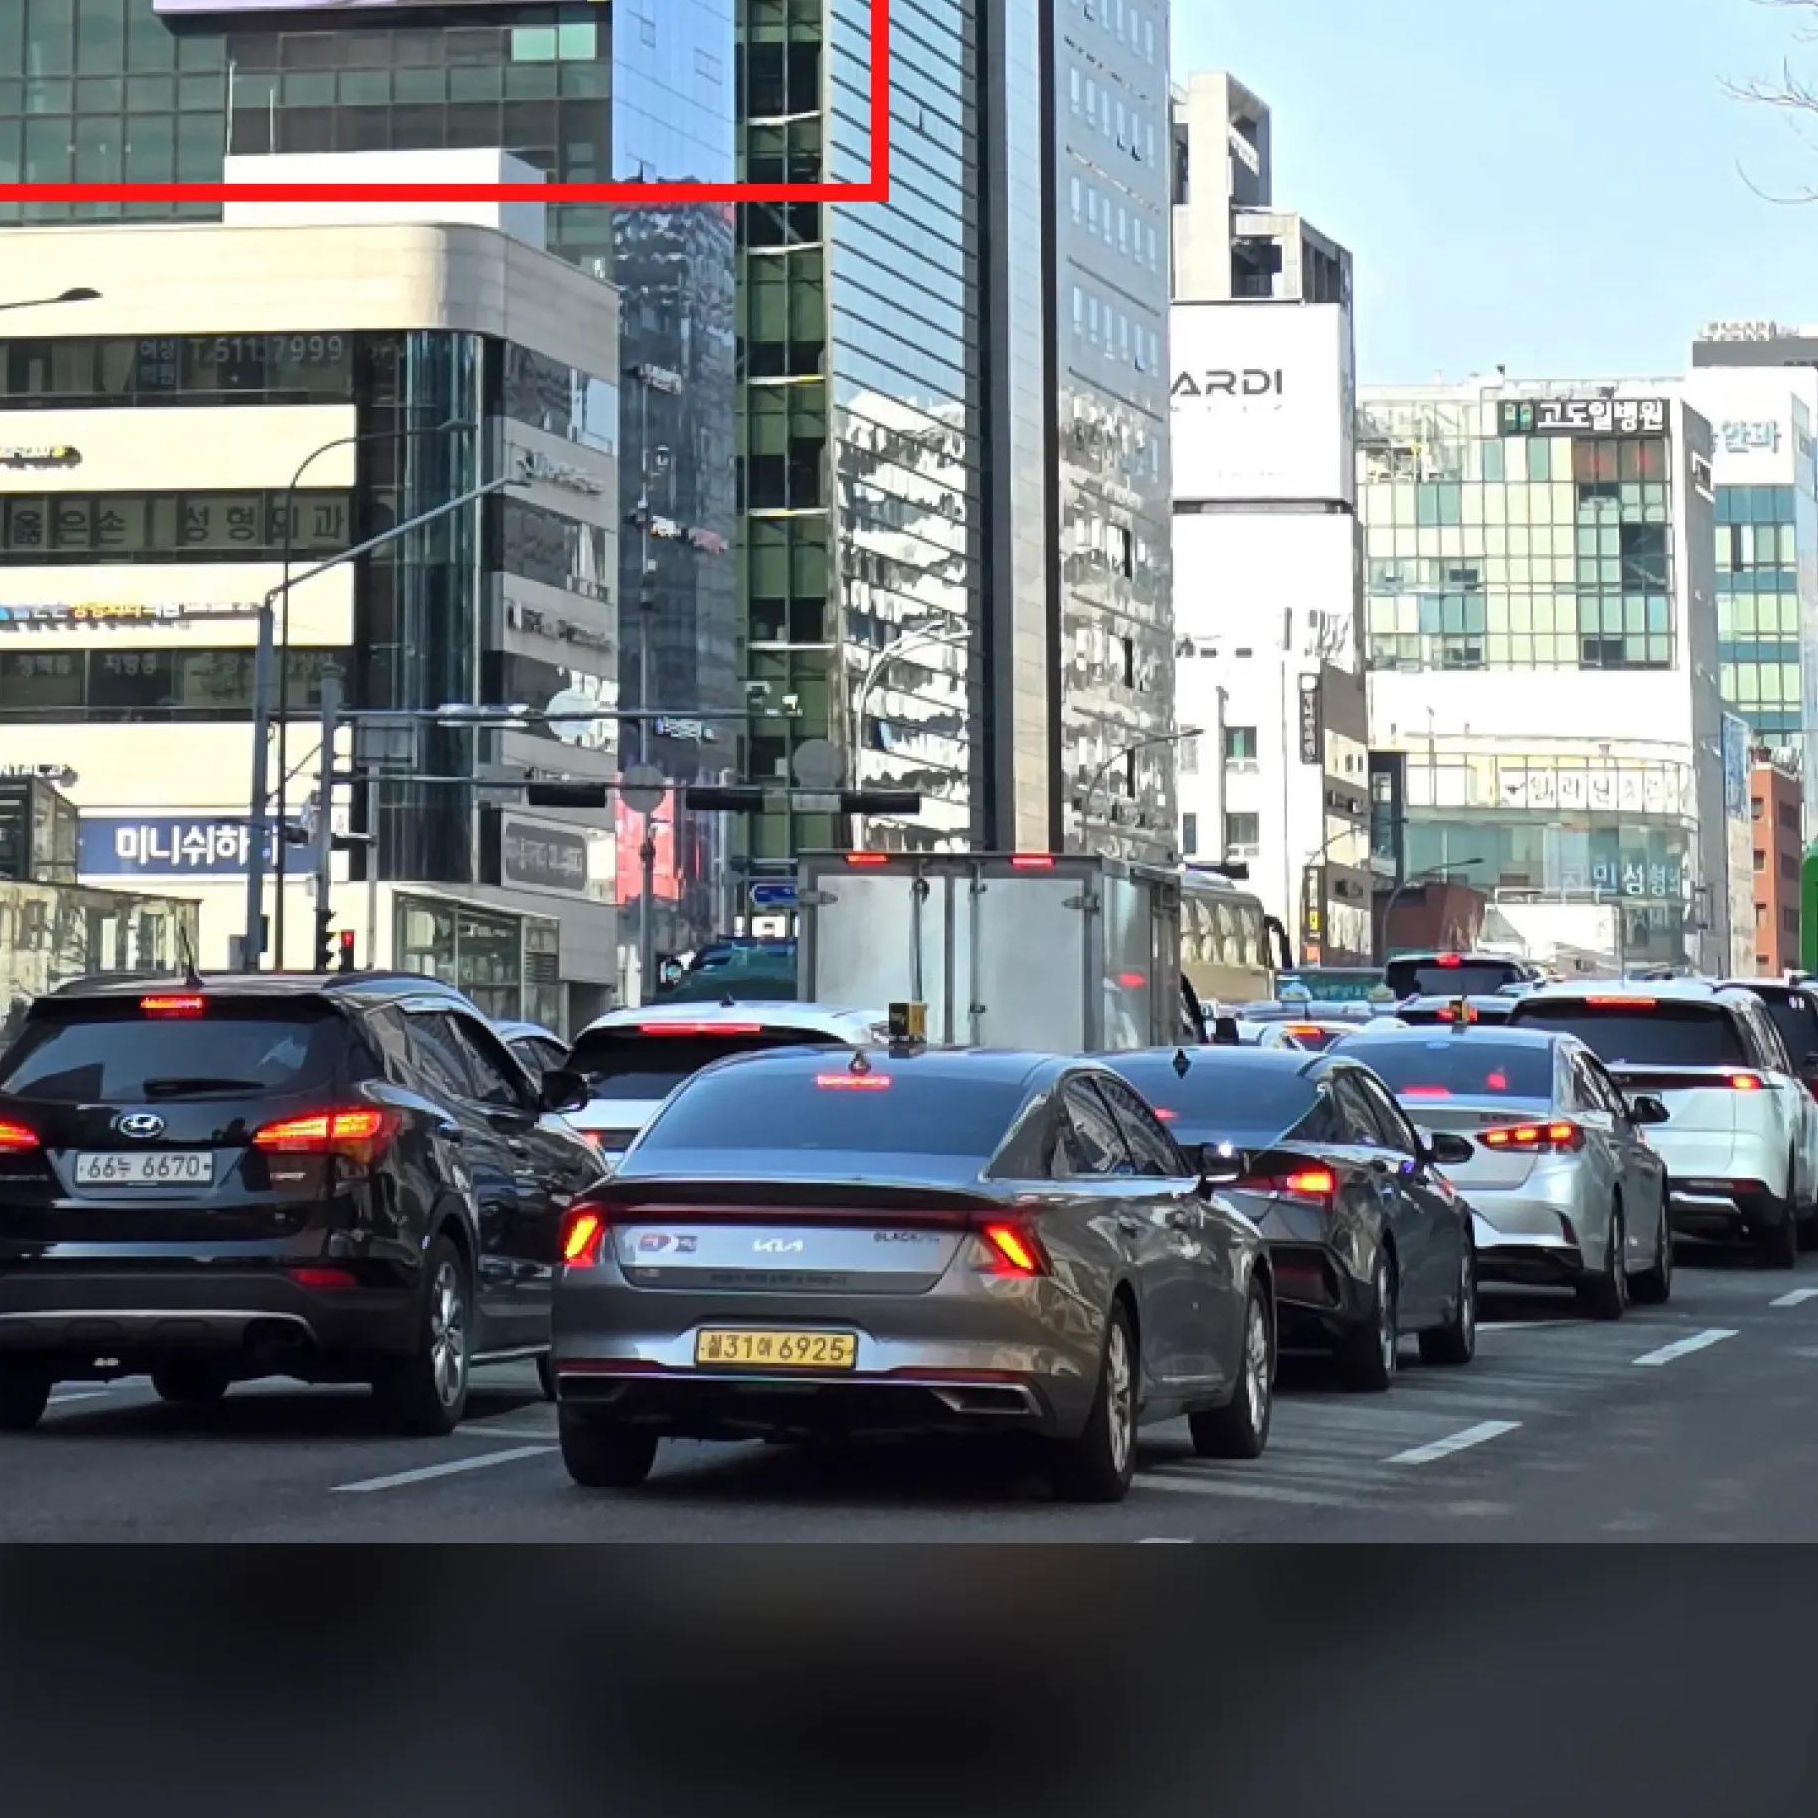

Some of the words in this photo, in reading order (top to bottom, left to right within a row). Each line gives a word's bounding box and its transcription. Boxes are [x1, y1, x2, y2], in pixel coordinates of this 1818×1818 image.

[1169, 368, 1284, 397] ARDI
[1537, 400, 1664, 432] 고도일병원
[182, 504, 346, 543] 성형외과
[142, 1154, 201, 1178] 6670
[778, 1336, 846, 1362] 6925
